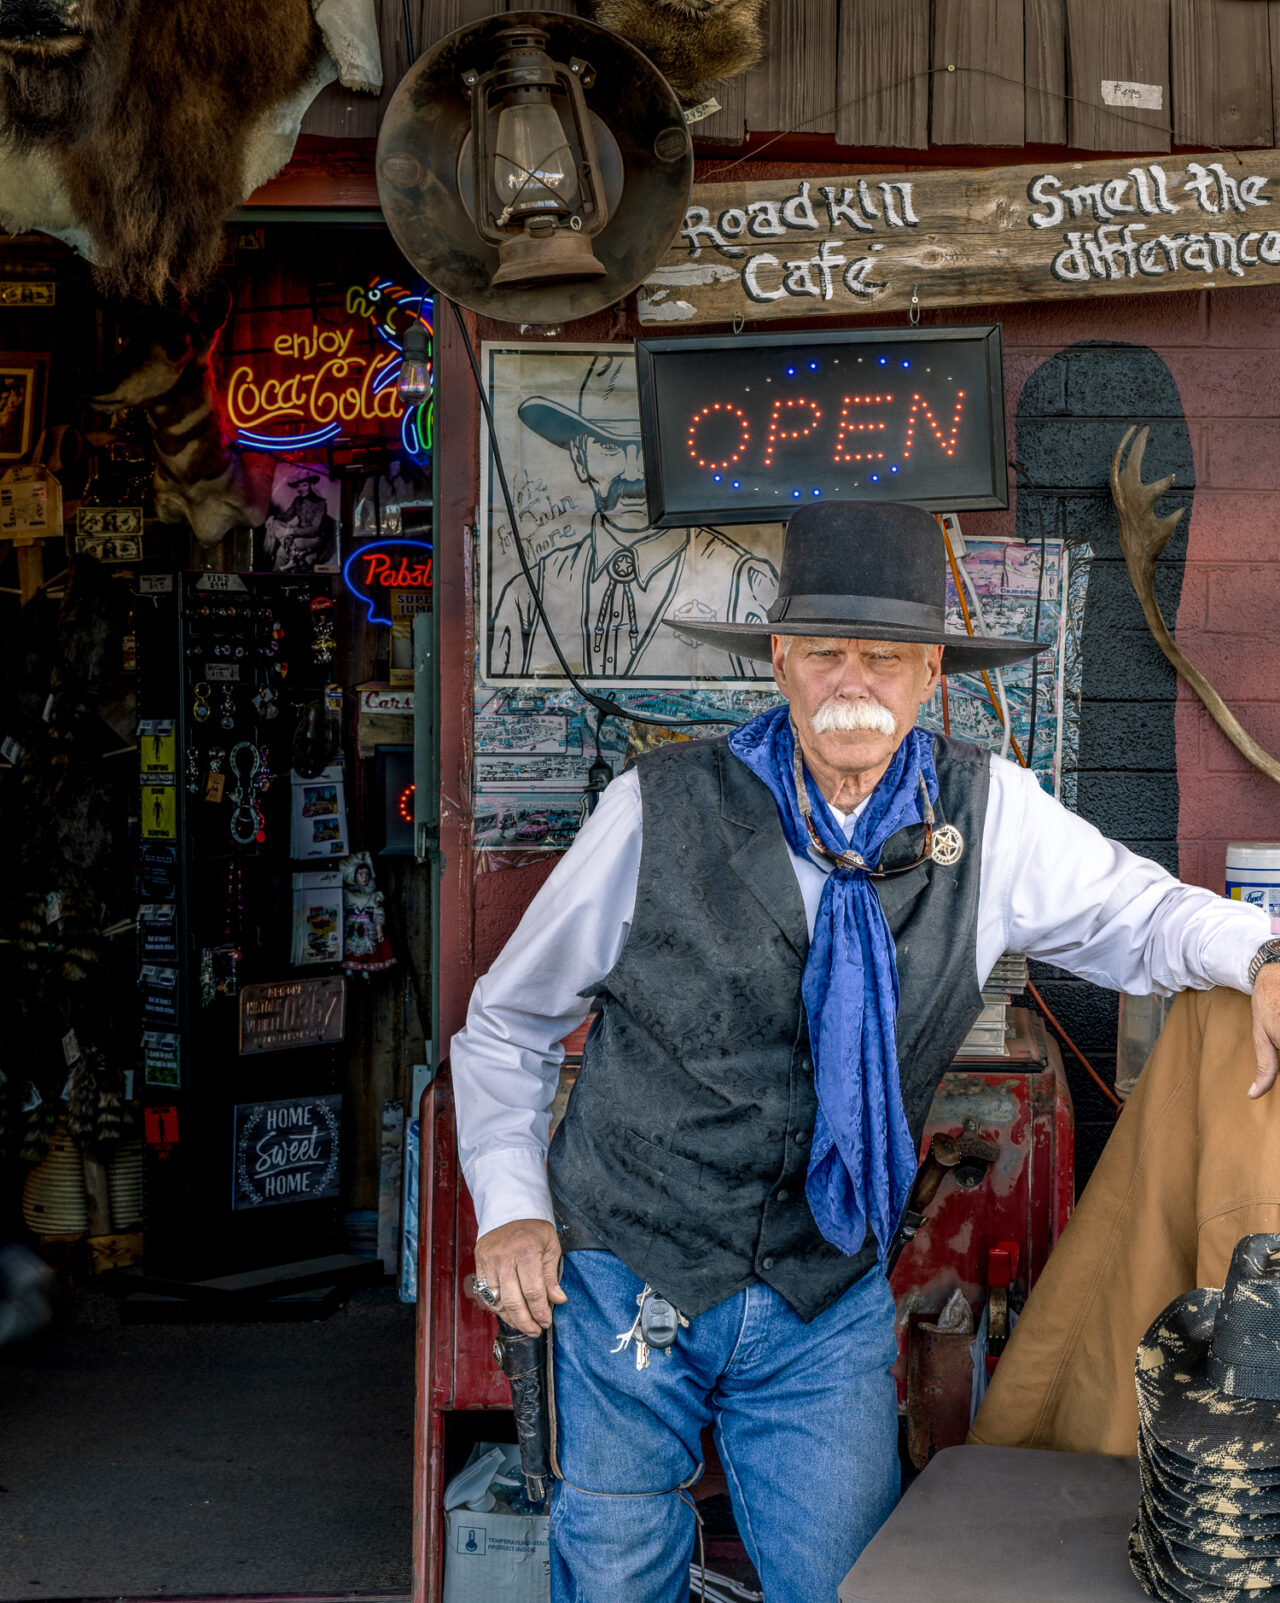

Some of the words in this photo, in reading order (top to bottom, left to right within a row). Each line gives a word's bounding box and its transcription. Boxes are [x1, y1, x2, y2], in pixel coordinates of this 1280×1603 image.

[1026, 164, 1182, 229] Smell
[1184, 162, 1274, 216] the
[273, 324, 355, 360] enjoy
[227, 352, 405, 428] Coca-Cola
[686, 389, 966, 471] OPEN
[397, 594, 434, 605] SUPE
[266, 1105, 314, 1131] HOME
[255, 1125, 328, 1172] Sweet
[265, 1172, 313, 1198] HOME
[487, 1537, 550, 1548] TEMPERATURE-SENS
[487, 1544, 515, 1553] PRODUCT
